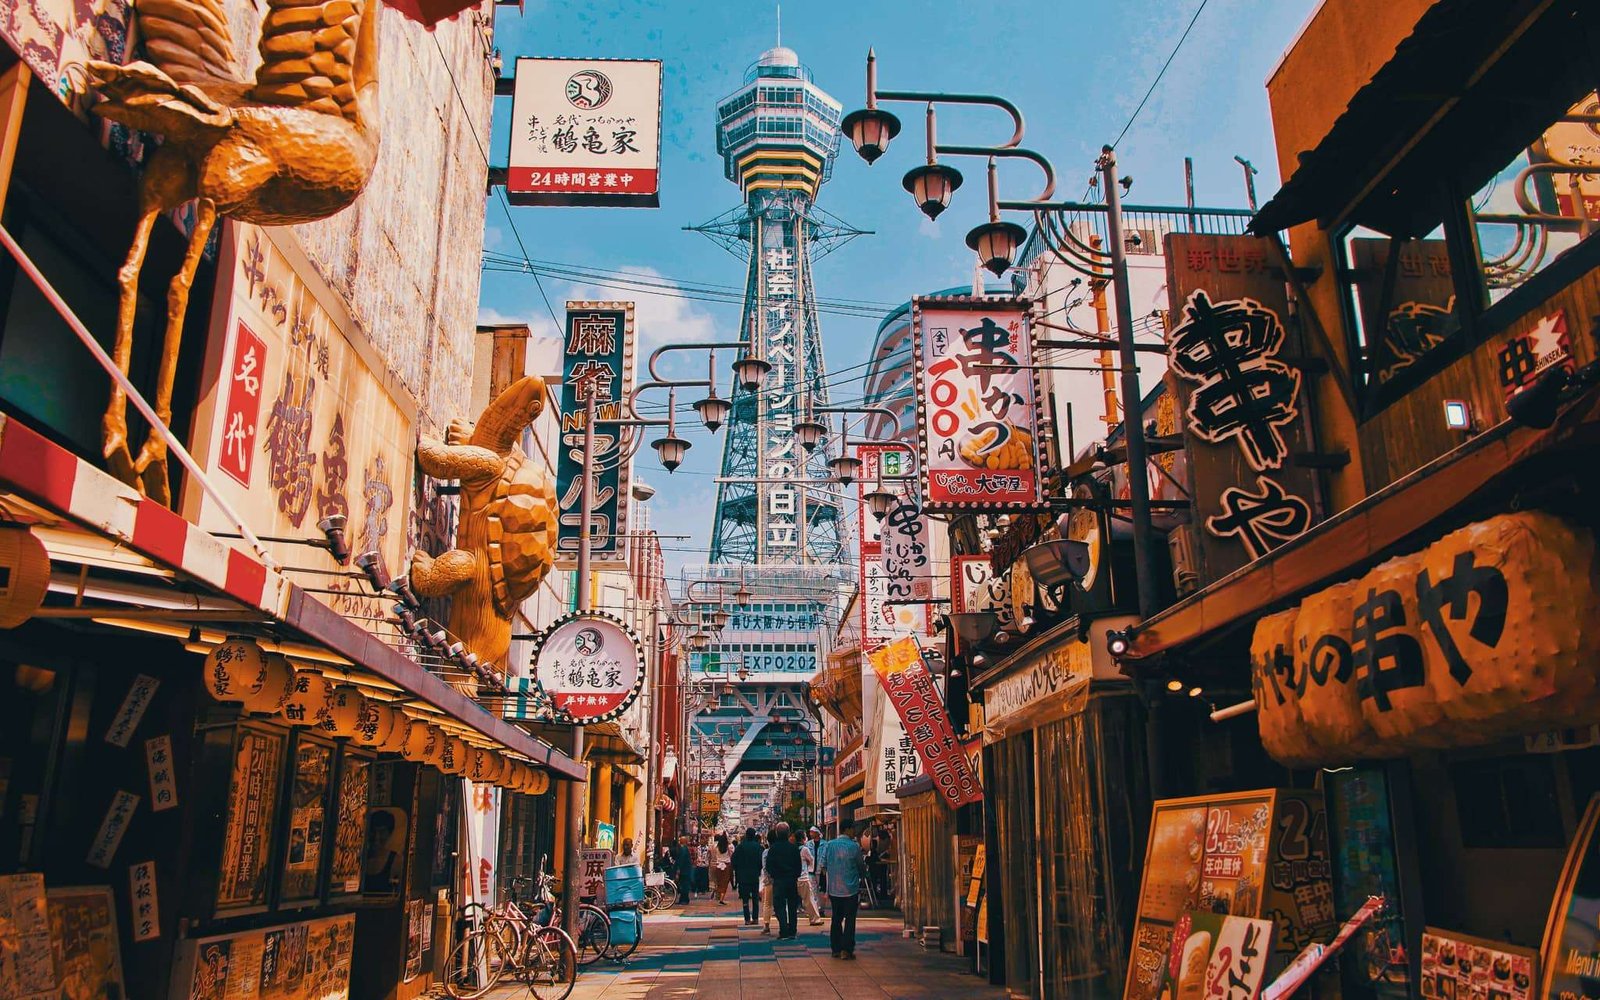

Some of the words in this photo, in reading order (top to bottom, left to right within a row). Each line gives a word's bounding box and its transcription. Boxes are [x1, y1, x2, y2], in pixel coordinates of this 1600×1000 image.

[552, 124, 640, 154] 鶴亀家
[531, 172, 634, 187] 24時間営業中
[1186, 248, 1268, 273] 新世界
[932, 331, 947, 355] 全て
[1008, 320, 1020, 353] 新世界
[567, 313, 616, 402] 麻雀
[767, 247, 797, 547] 社会イノベーションの日立
[955, 317, 1025, 455] 串かつ
[224, 345, 259, 473] 名代
[888, 503, 927, 568] 串かつ
[214, 645, 235, 695] 鶴亀家
[568, 667, 623, 688] 鶴亀家
[566, 695, 609, 706] 年中無休
[885, 746, 897, 794] 通天閣店
[1204, 856, 1242, 876] 年中無休
